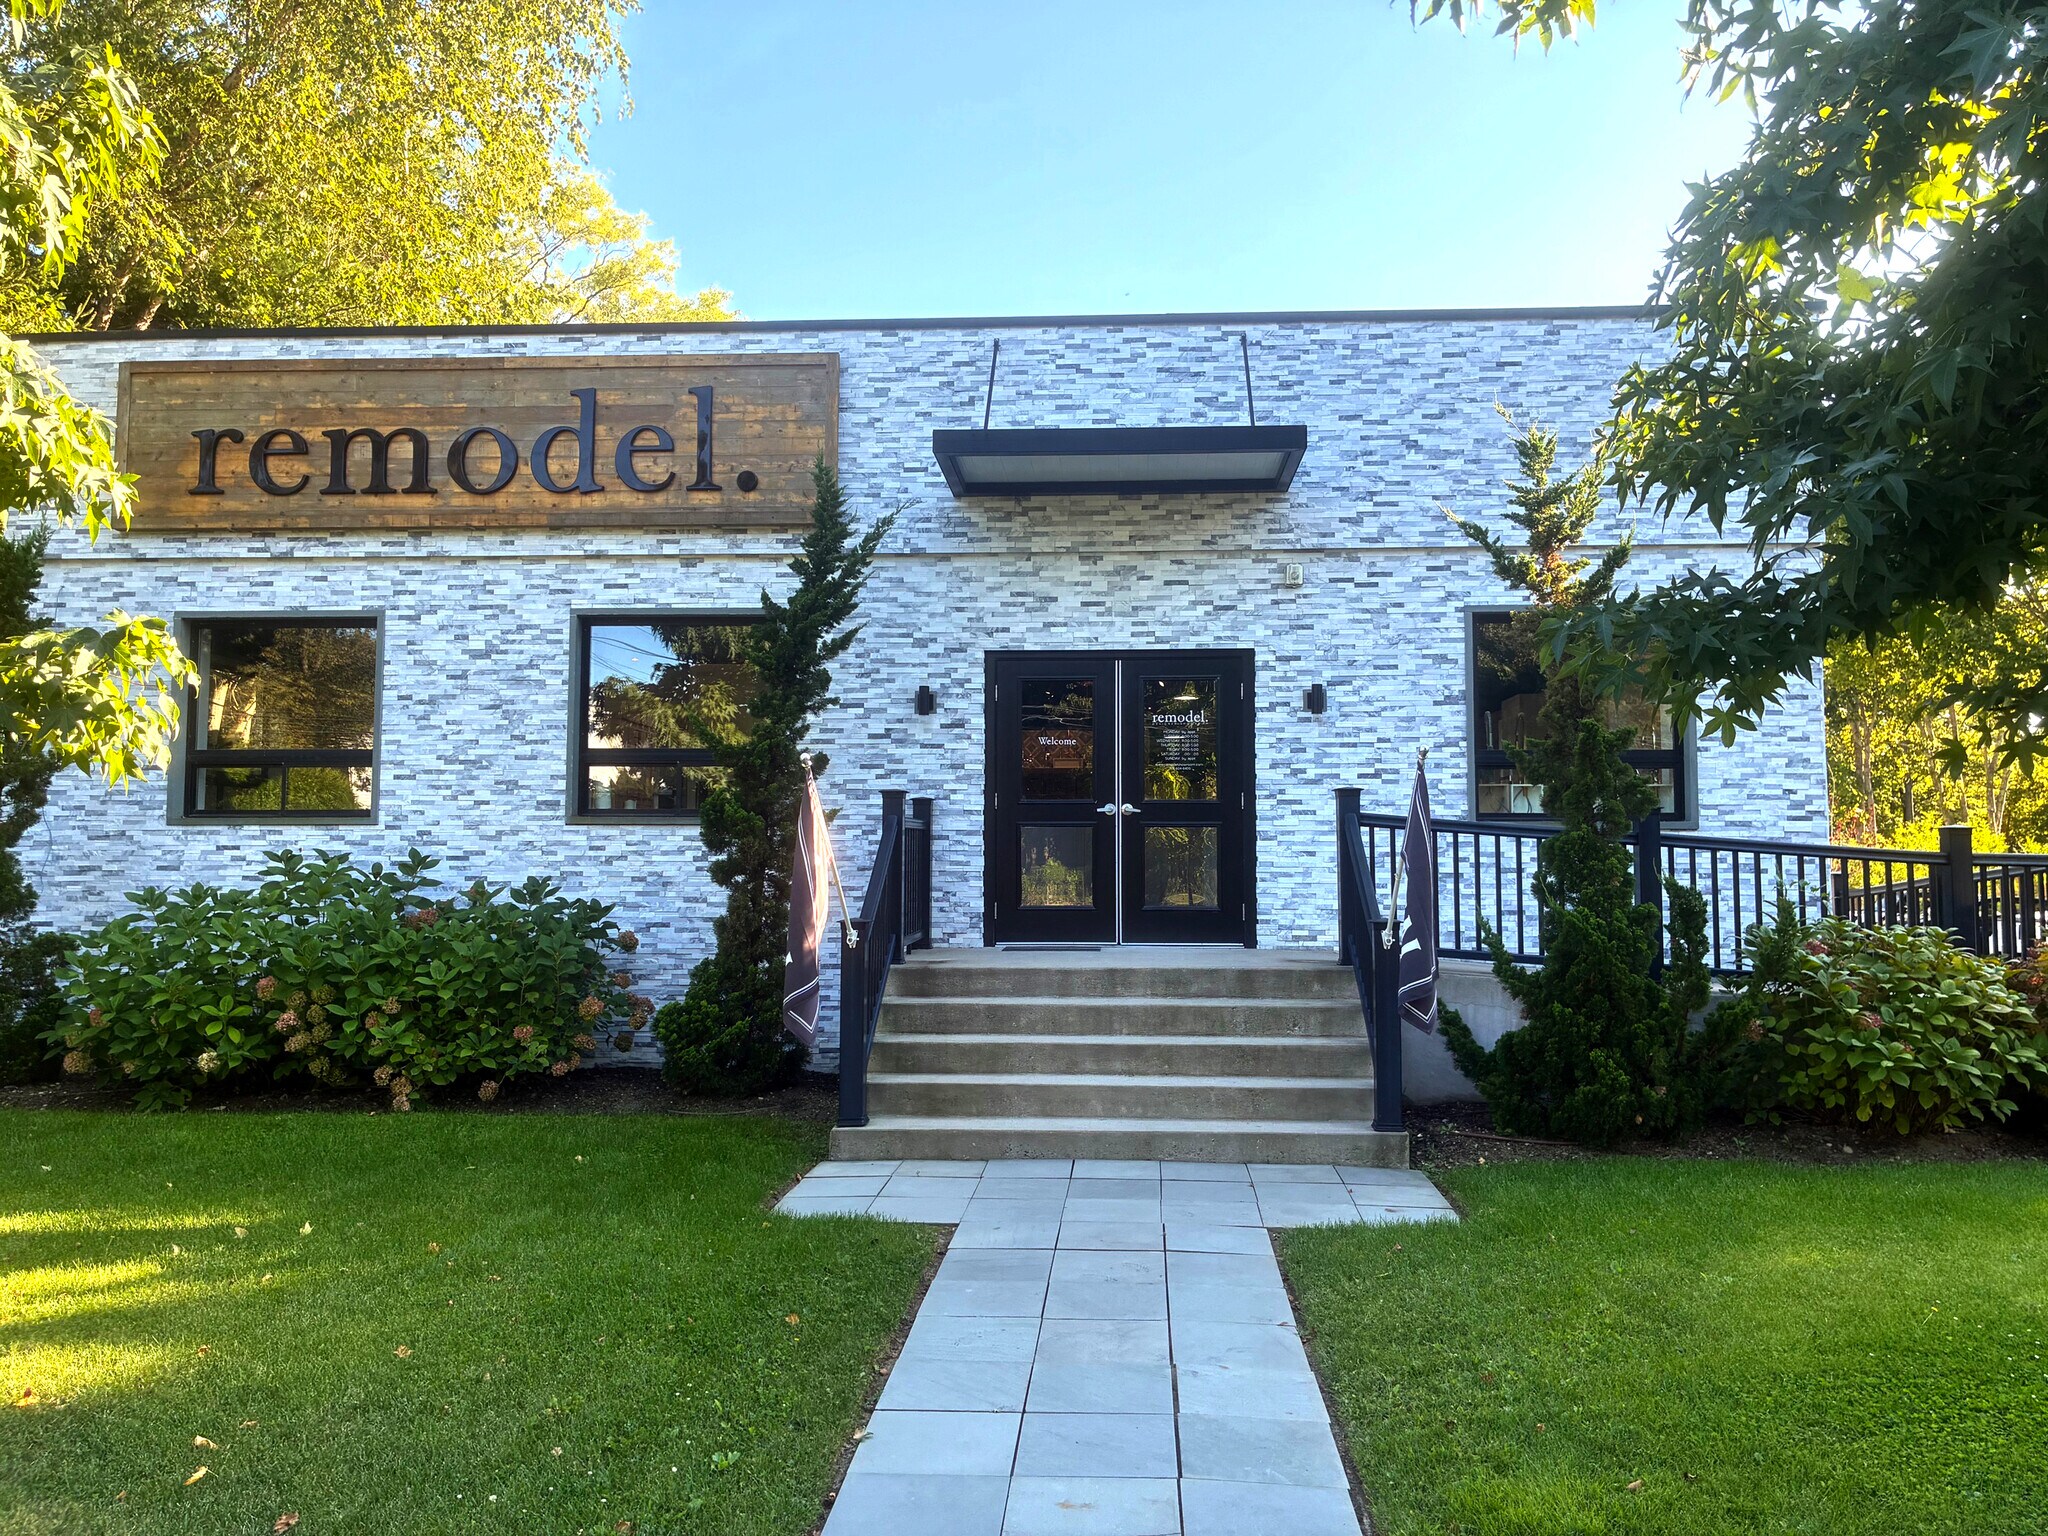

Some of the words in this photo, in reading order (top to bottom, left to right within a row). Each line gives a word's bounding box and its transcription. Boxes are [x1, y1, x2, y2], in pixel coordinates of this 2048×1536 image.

[187, 386, 760, 496] remodel.
[1152, 710, 1209, 723] remodel.
[1038, 736, 1077, 746] Welcome
